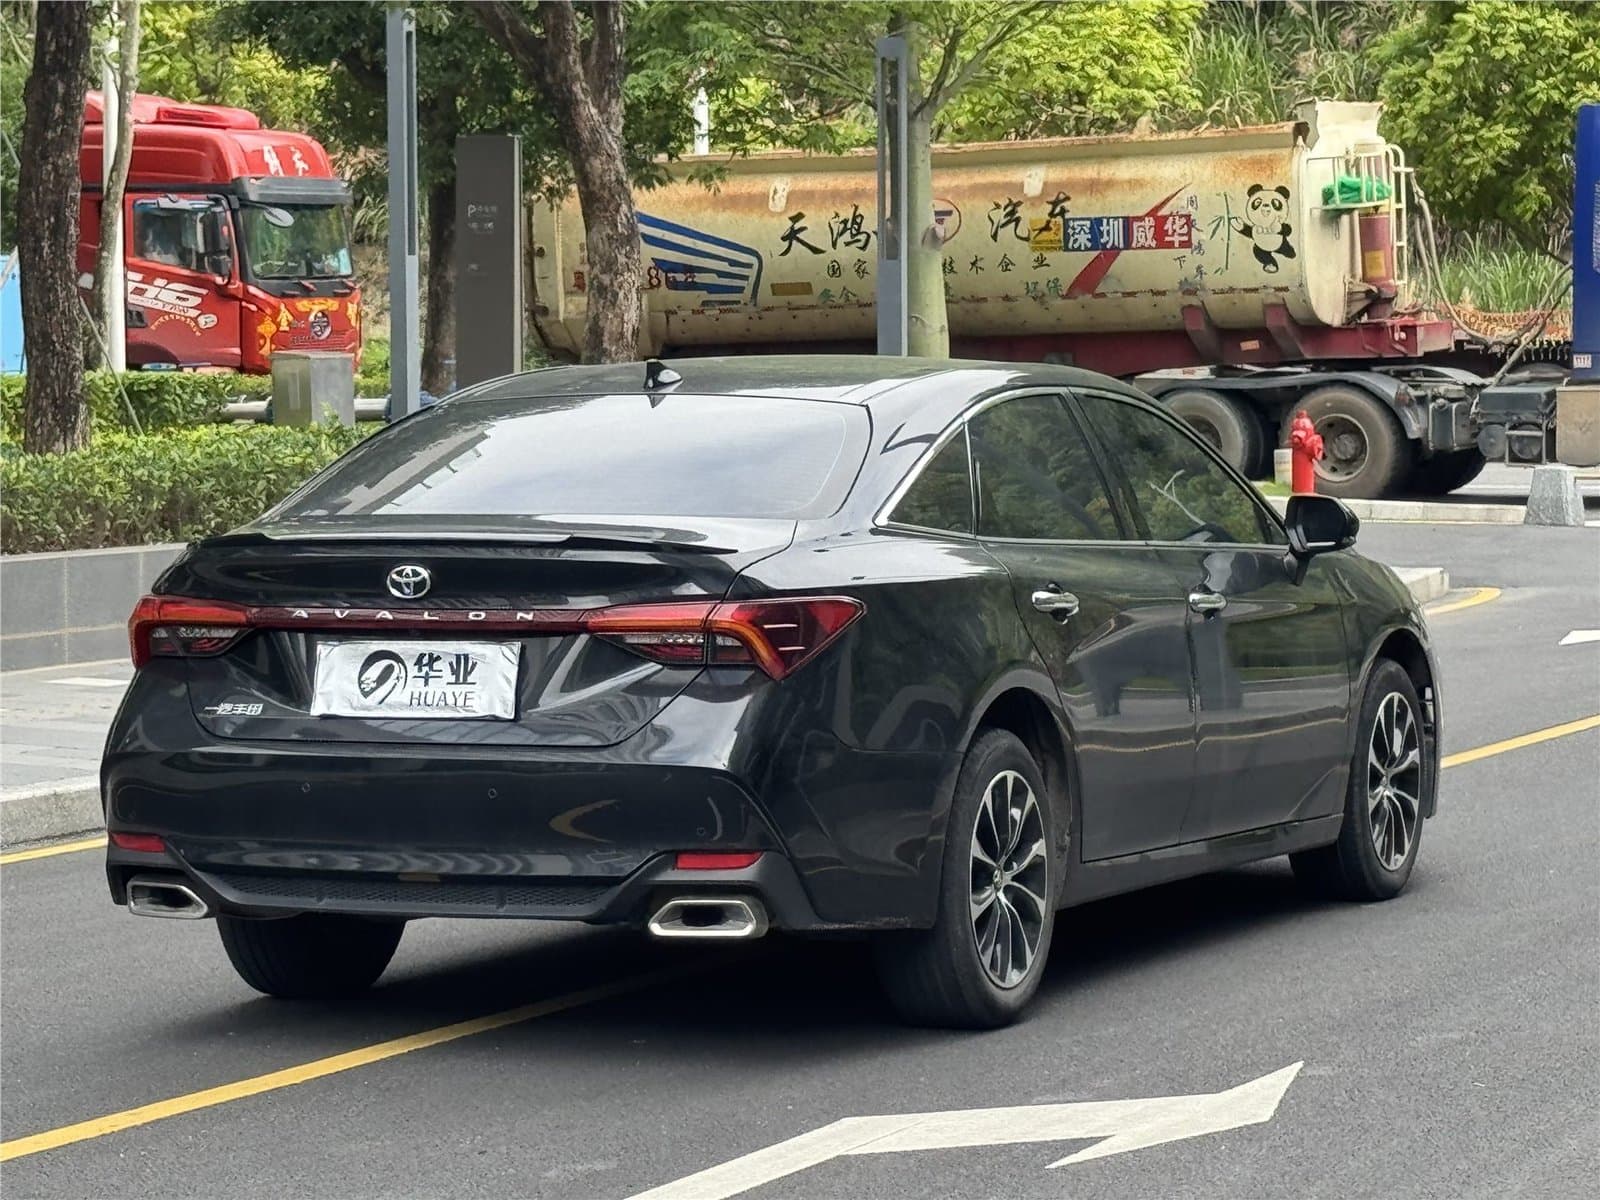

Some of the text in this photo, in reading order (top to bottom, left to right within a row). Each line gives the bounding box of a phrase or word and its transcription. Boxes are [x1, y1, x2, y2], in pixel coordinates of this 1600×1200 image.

[1066, 216, 1190, 251] 深圳威华
[826, 258, 870, 280] 国家
[291, 608, 535, 621] AVALON
[411, 652, 478, 687] 华业
[408, 690, 475, 708] HUAYE
